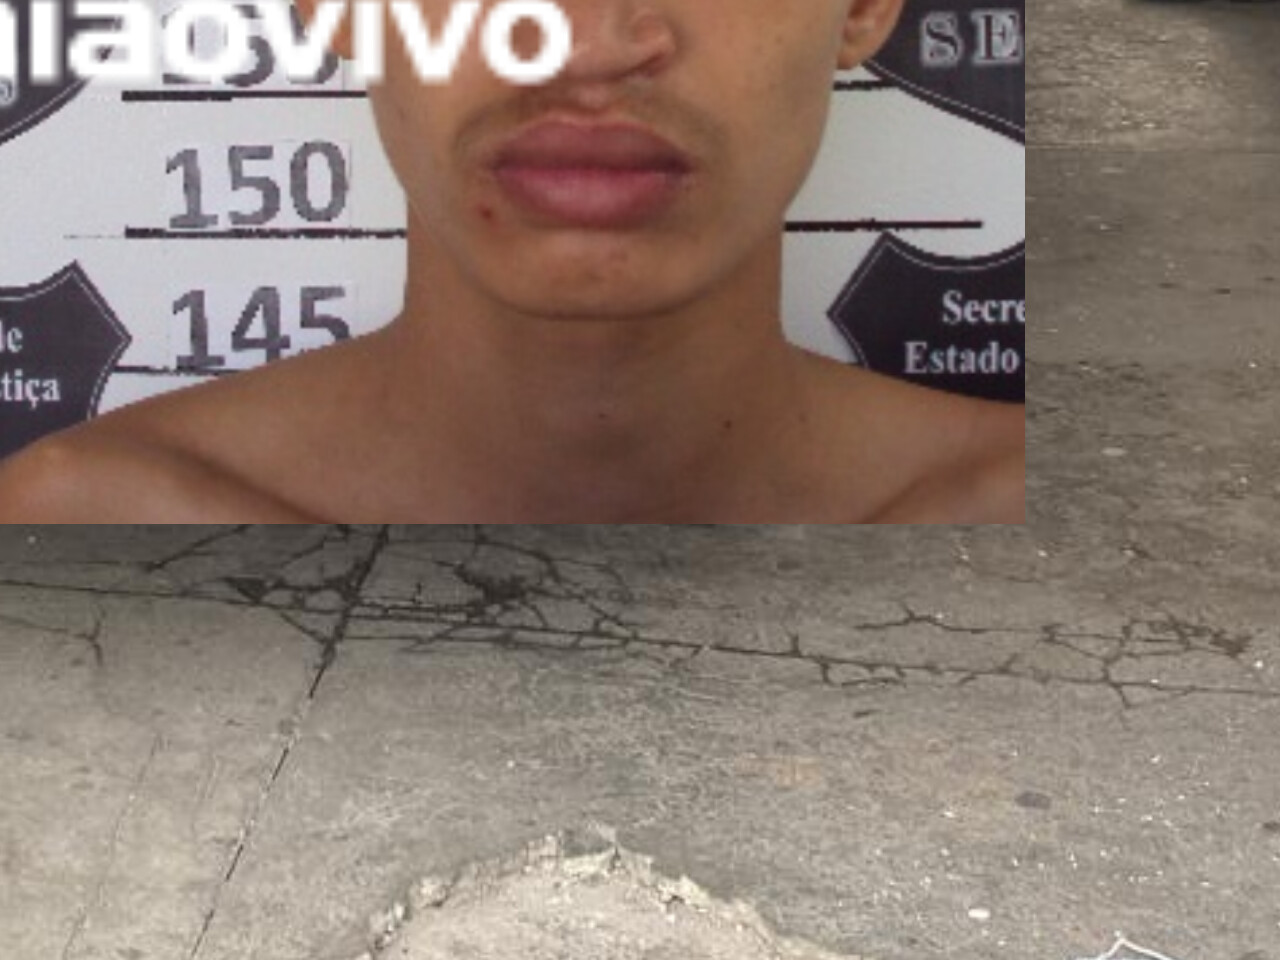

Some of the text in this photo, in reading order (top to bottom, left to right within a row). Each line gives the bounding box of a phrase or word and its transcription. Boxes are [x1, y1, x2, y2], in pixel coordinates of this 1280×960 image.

[166, 140, 350, 229] 150
[172, 286, 351, 367] 145
[904, 341, 1020, 374] Estado
